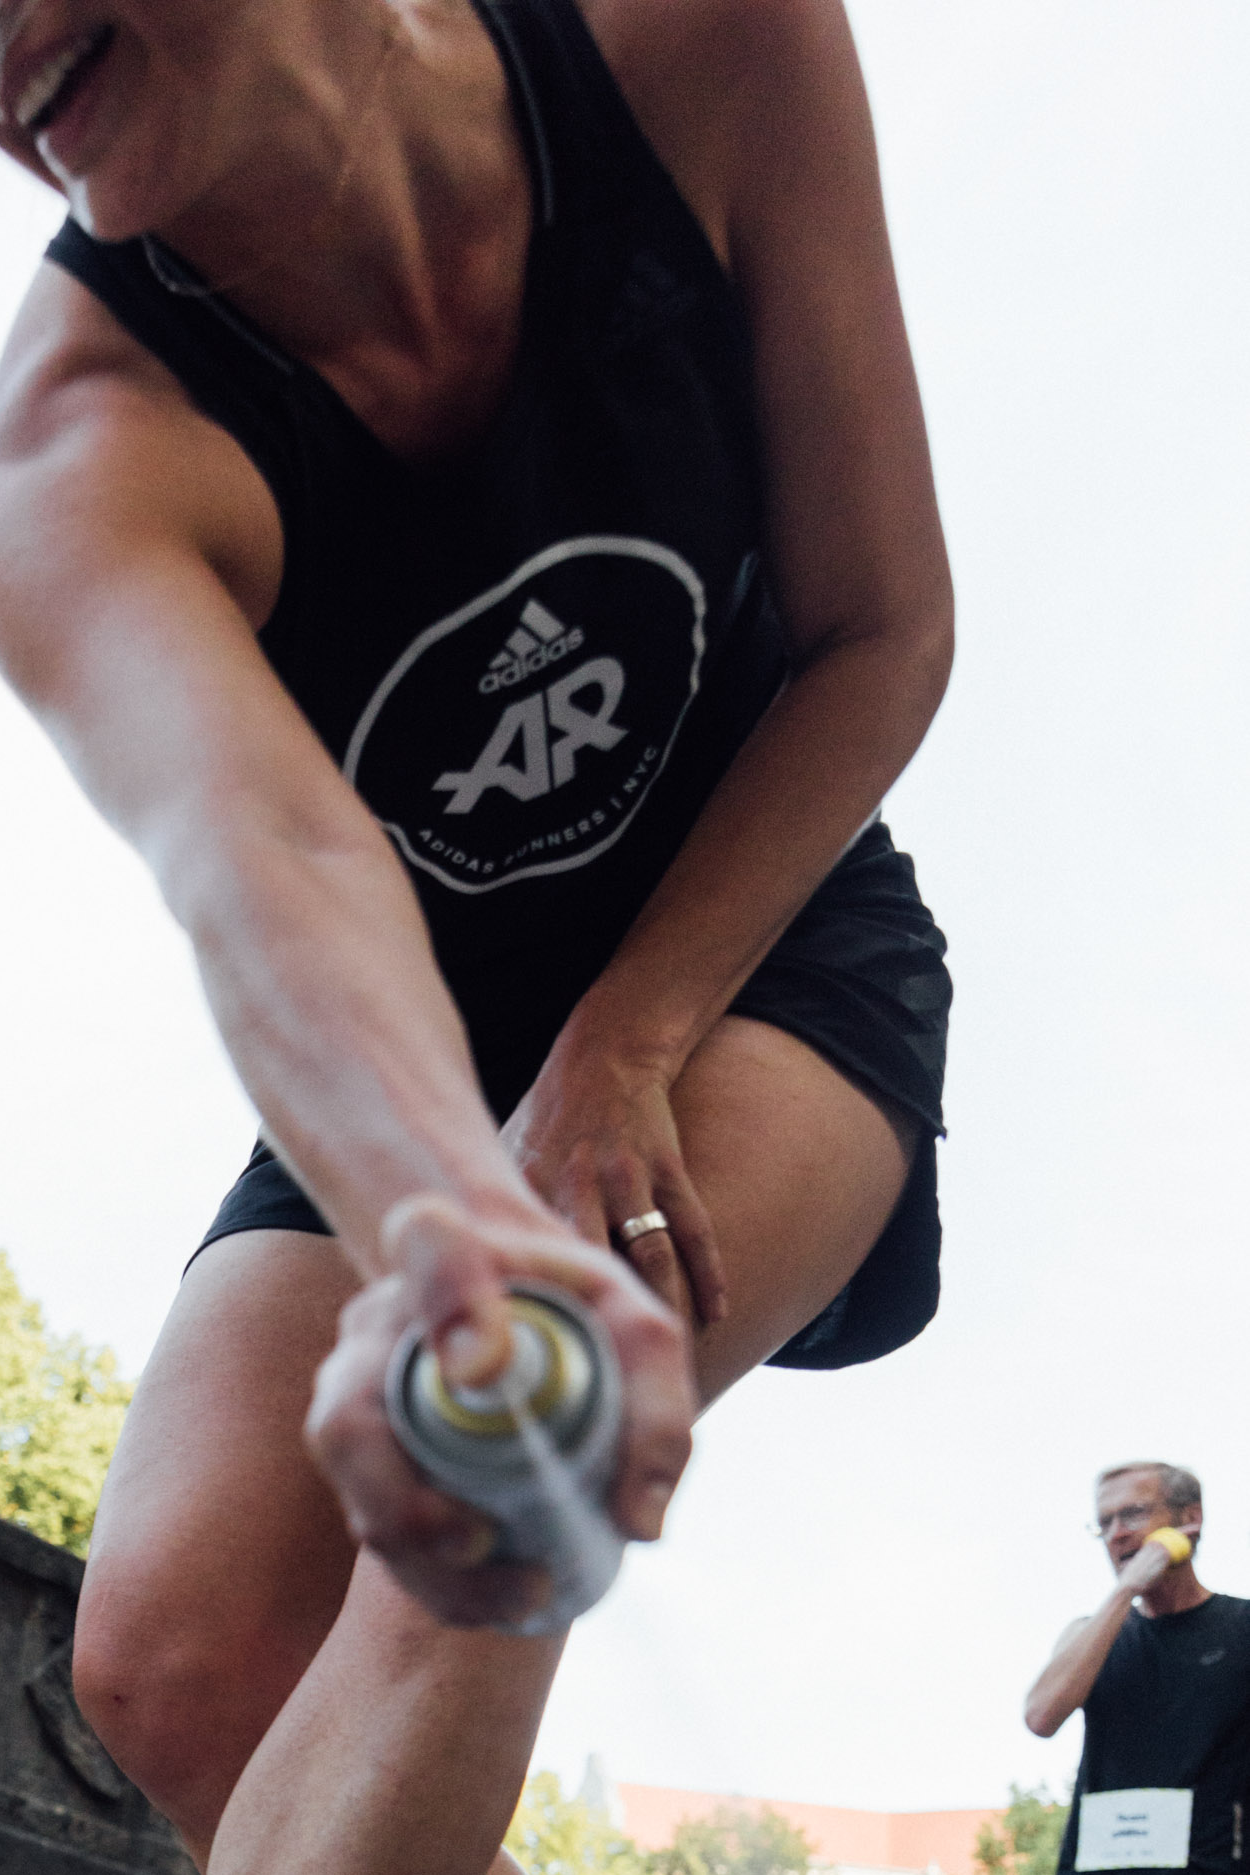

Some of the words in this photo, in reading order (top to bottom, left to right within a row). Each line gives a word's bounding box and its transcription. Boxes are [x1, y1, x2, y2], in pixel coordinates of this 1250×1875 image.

[478, 626, 585, 694] adidas
[418, 828, 496, 875] ADIDAS
[622, 746, 659, 795] NYC
